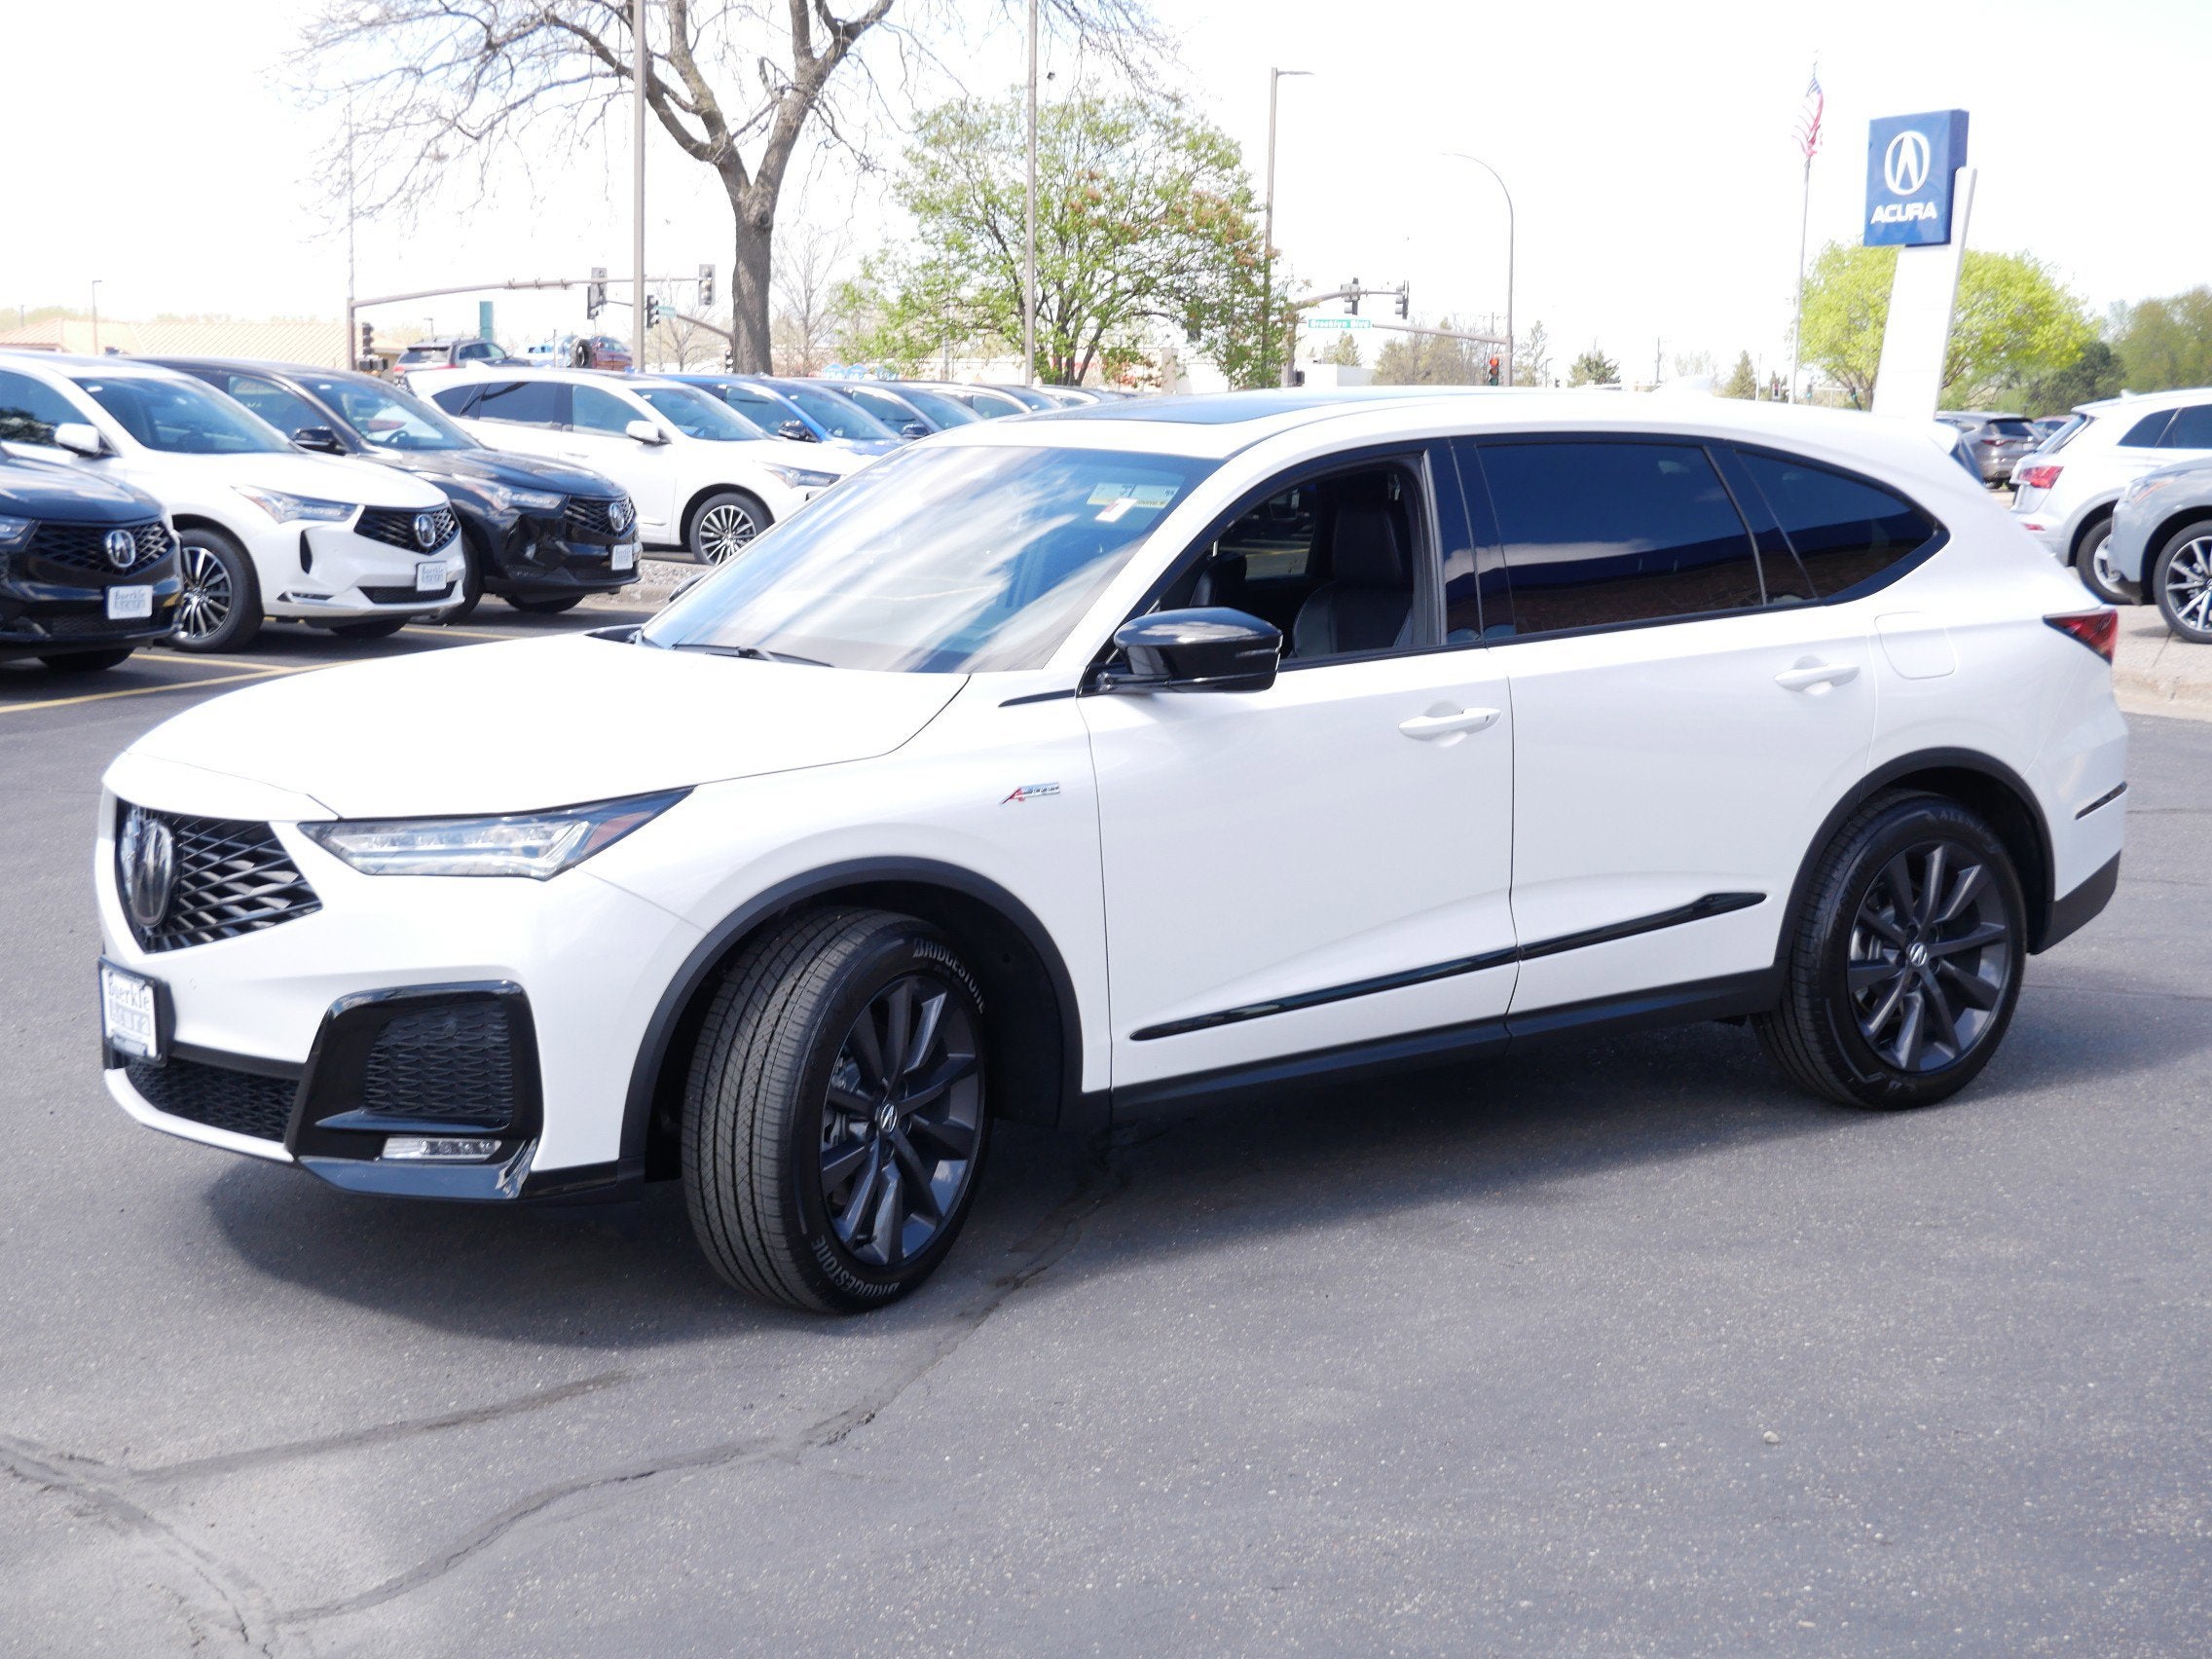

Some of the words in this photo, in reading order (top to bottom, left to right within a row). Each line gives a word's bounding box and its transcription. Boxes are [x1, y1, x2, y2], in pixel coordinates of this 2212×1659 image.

[1870, 202, 1937, 224] ACURA
[912, 938, 985, 1014] BRIDGESTONE
[811, 1235, 901, 1298] BRIDGESTONE
